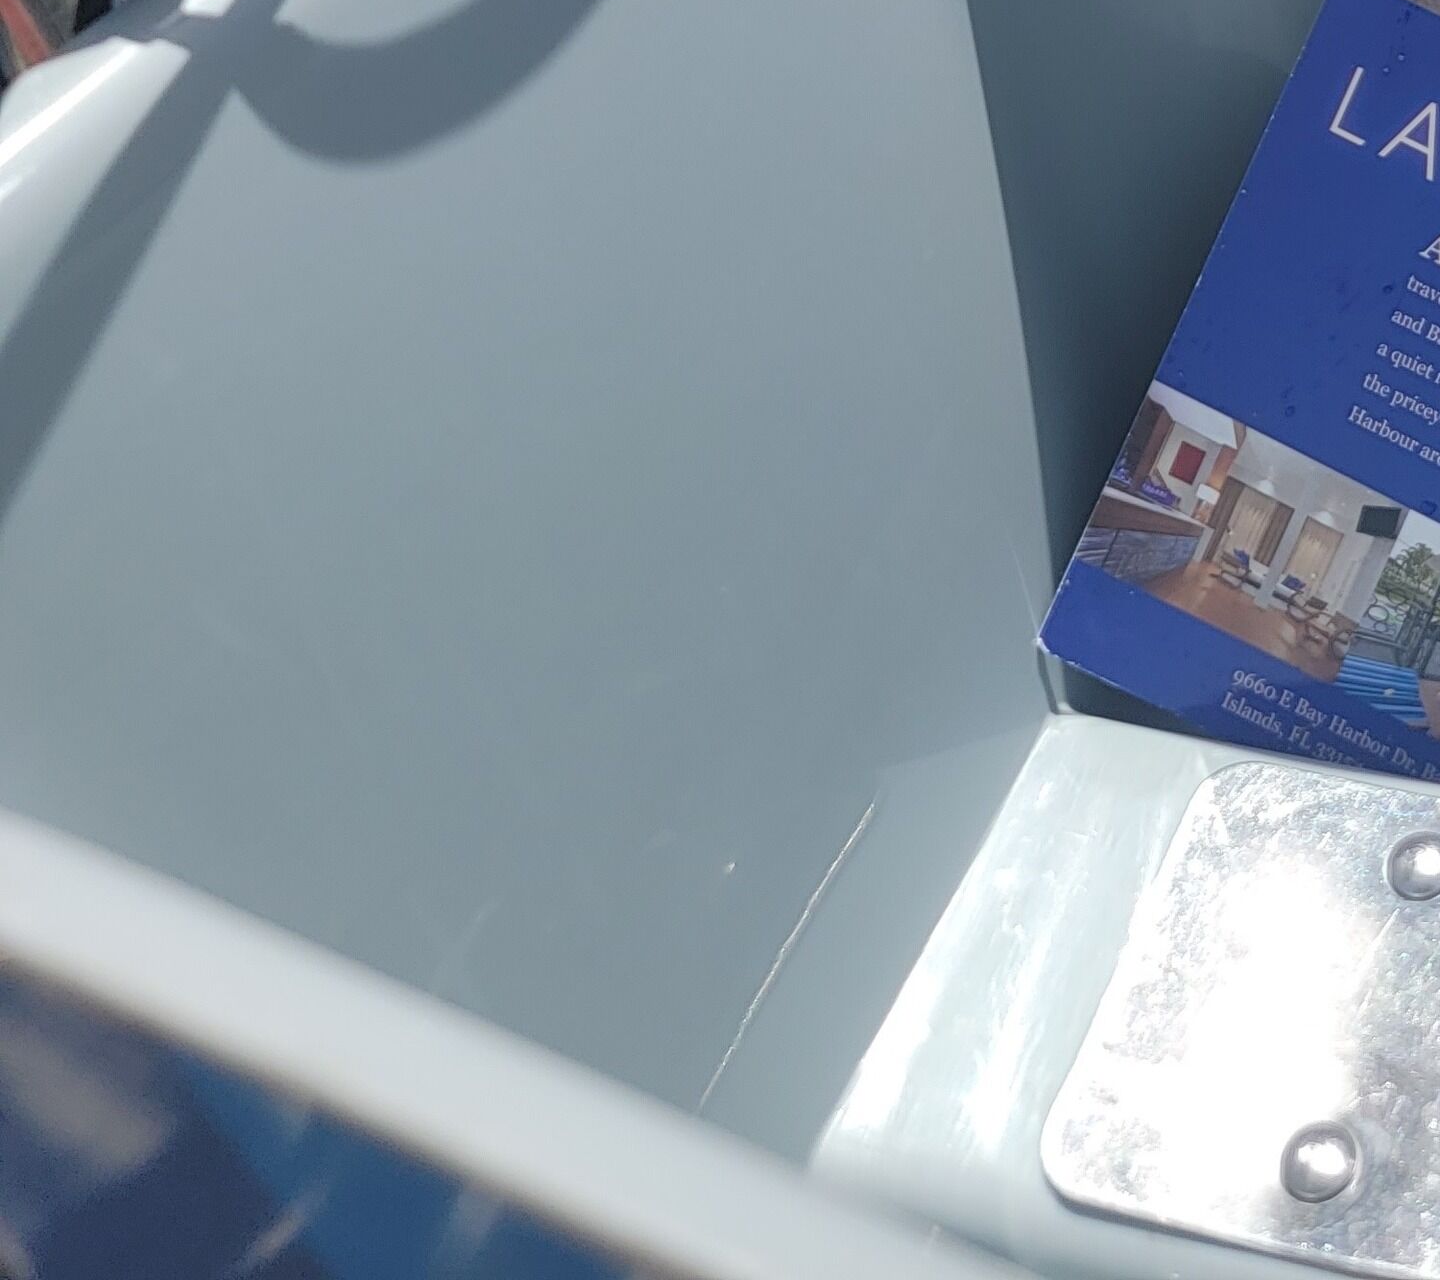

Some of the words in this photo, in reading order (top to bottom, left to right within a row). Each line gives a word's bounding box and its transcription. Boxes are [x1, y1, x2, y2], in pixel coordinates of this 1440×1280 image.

[1391, 311, 1426, 335] and
[1376, 343, 1388, 357] a
[1390, 350, 1434, 380] quiet
[1363, 373, 1391, 398] the
[1347, 405, 1420, 452] Harbour
[1220, 691, 1285, 737] Islands,
[1288, 725, 1312, 750] FL
[1232, 669, 1276, 701] 9660
[1278, 689, 1292, 709] E
[1293, 695, 1328, 728] Bay
[1328, 714, 1391, 757] Harbor
